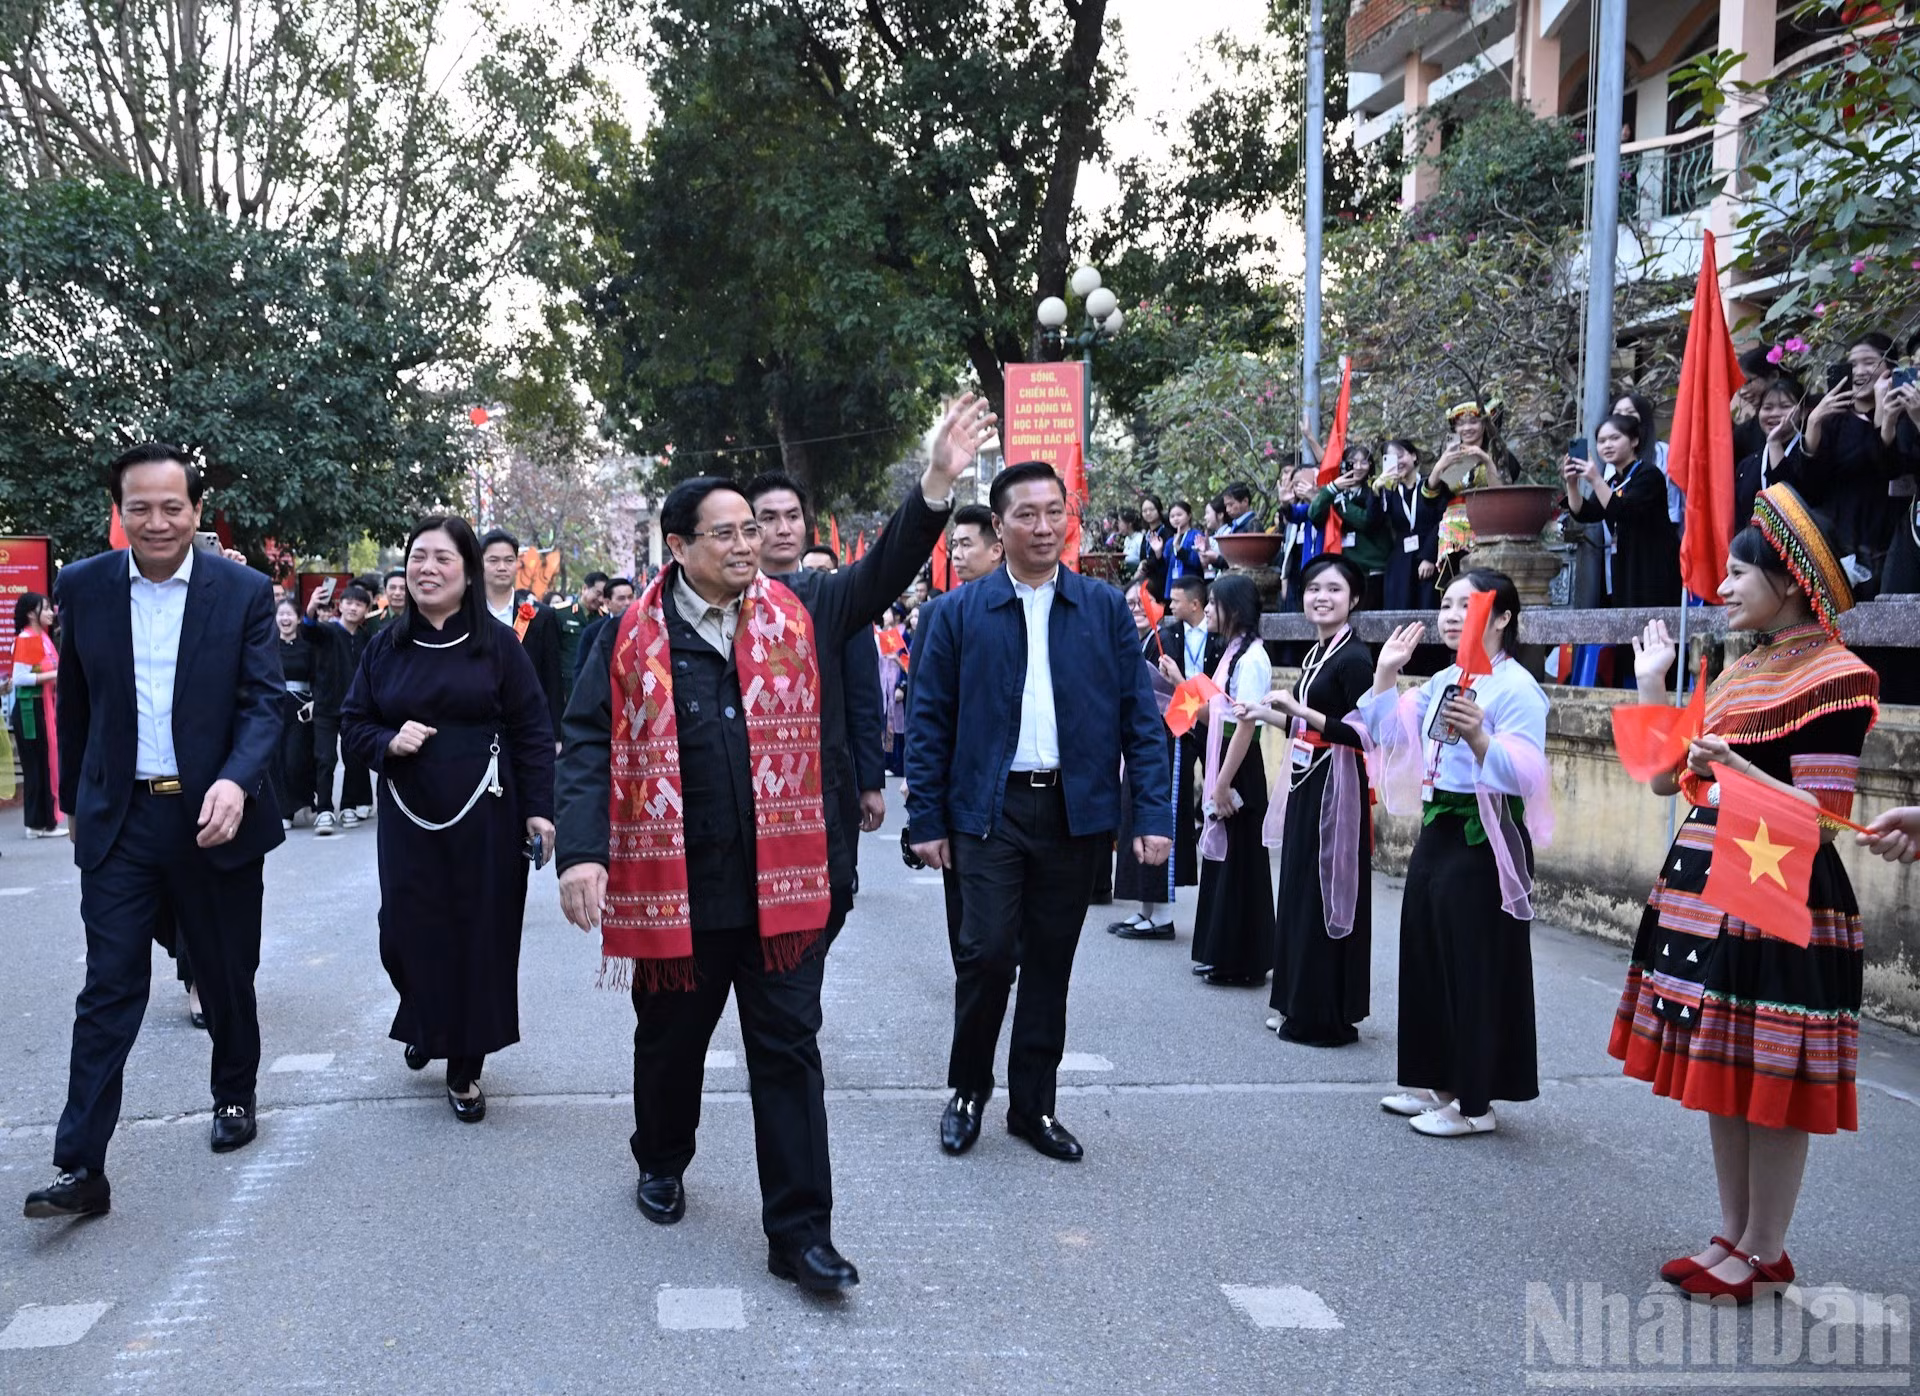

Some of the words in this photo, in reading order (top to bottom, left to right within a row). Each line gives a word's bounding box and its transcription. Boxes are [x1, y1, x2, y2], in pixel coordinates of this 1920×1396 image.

[1019, 386, 1046, 398] CHIẾN
[1015, 404, 1032, 414] LAO
[1034, 401, 1059, 416] ĐỘNG
[1061, 402, 1072, 413] VÀ
[1013, 419, 1031, 431] HỌC
[1034, 417, 1050, 431] TẬP
[1053, 418, 1075, 429] THEO
[1012, 434, 1042, 445] GƯƠNG
[1044, 432, 1061, 444] BÁC
[1041, 450, 1057, 462] ĐẠI
